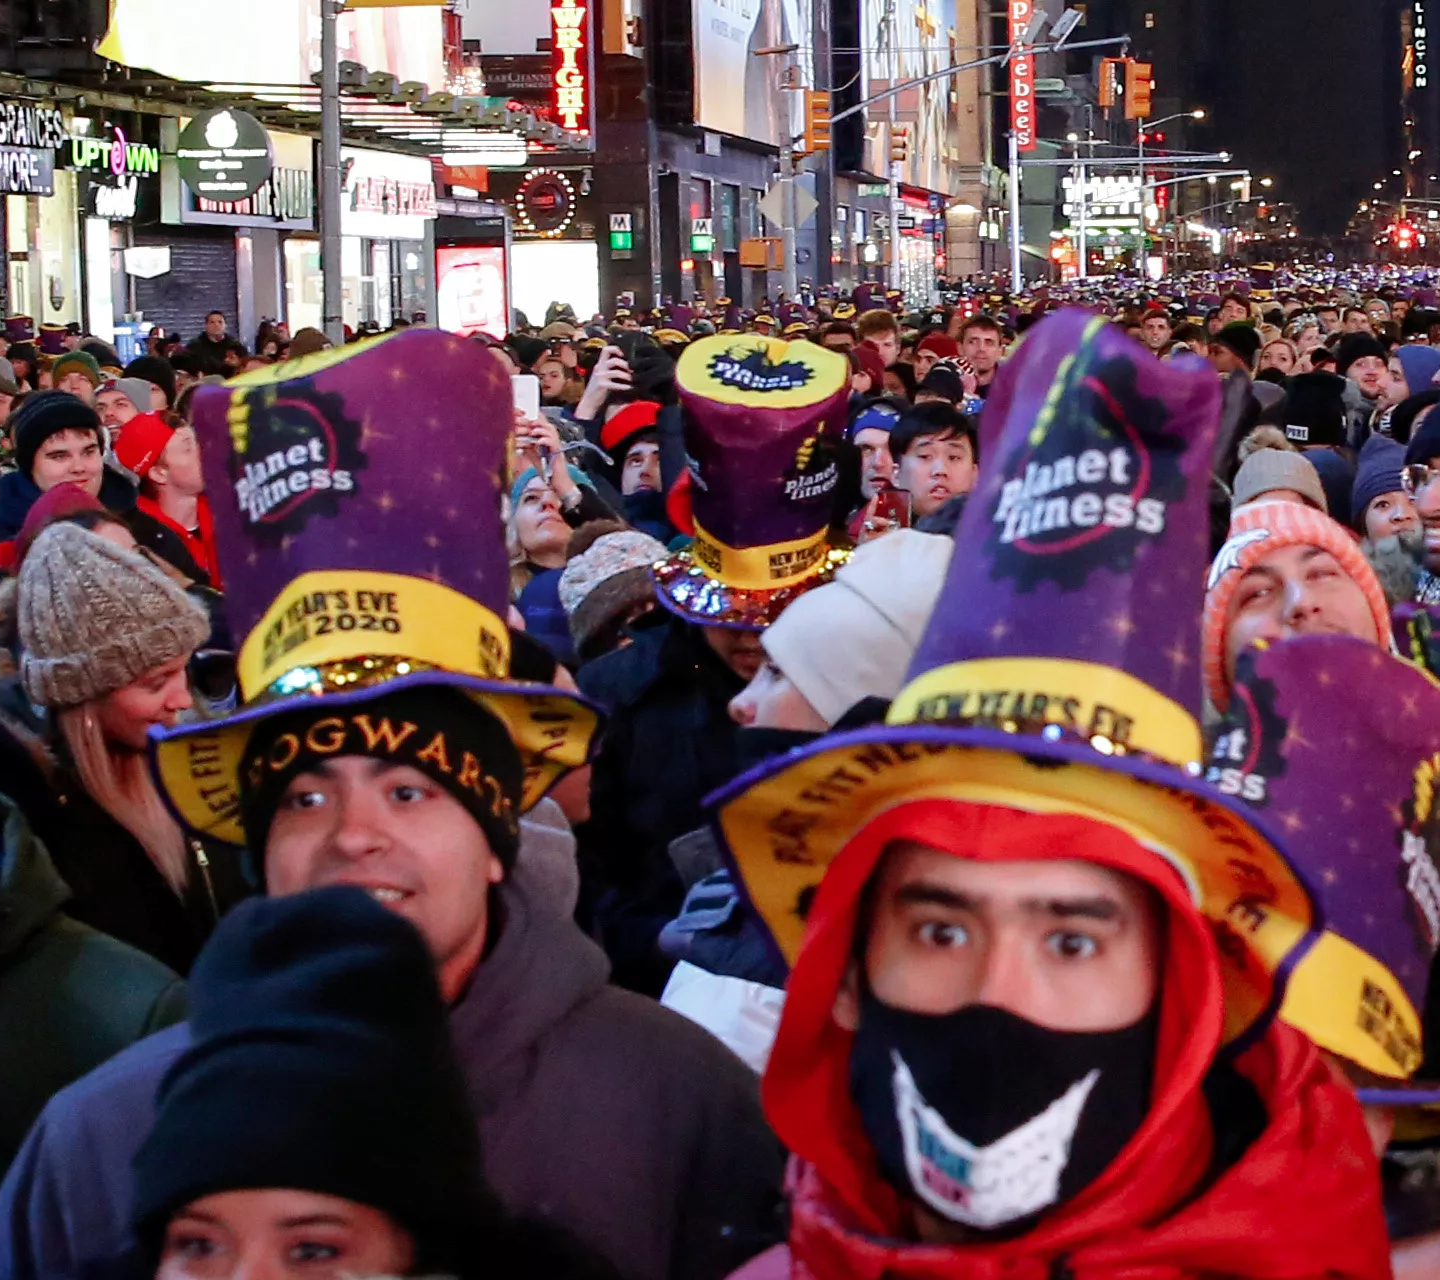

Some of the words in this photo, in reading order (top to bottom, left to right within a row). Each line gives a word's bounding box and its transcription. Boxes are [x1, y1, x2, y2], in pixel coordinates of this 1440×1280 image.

[72, 126, 159, 175] UPTOWN
[785, 462, 839, 498] planet
[994, 447, 1130, 522] planet
[1000, 492, 1165, 543] fitness
[315, 614, 402, 636] 2020
[355, 590, 399, 613] EVE
[252, 712, 515, 822] OGWART
